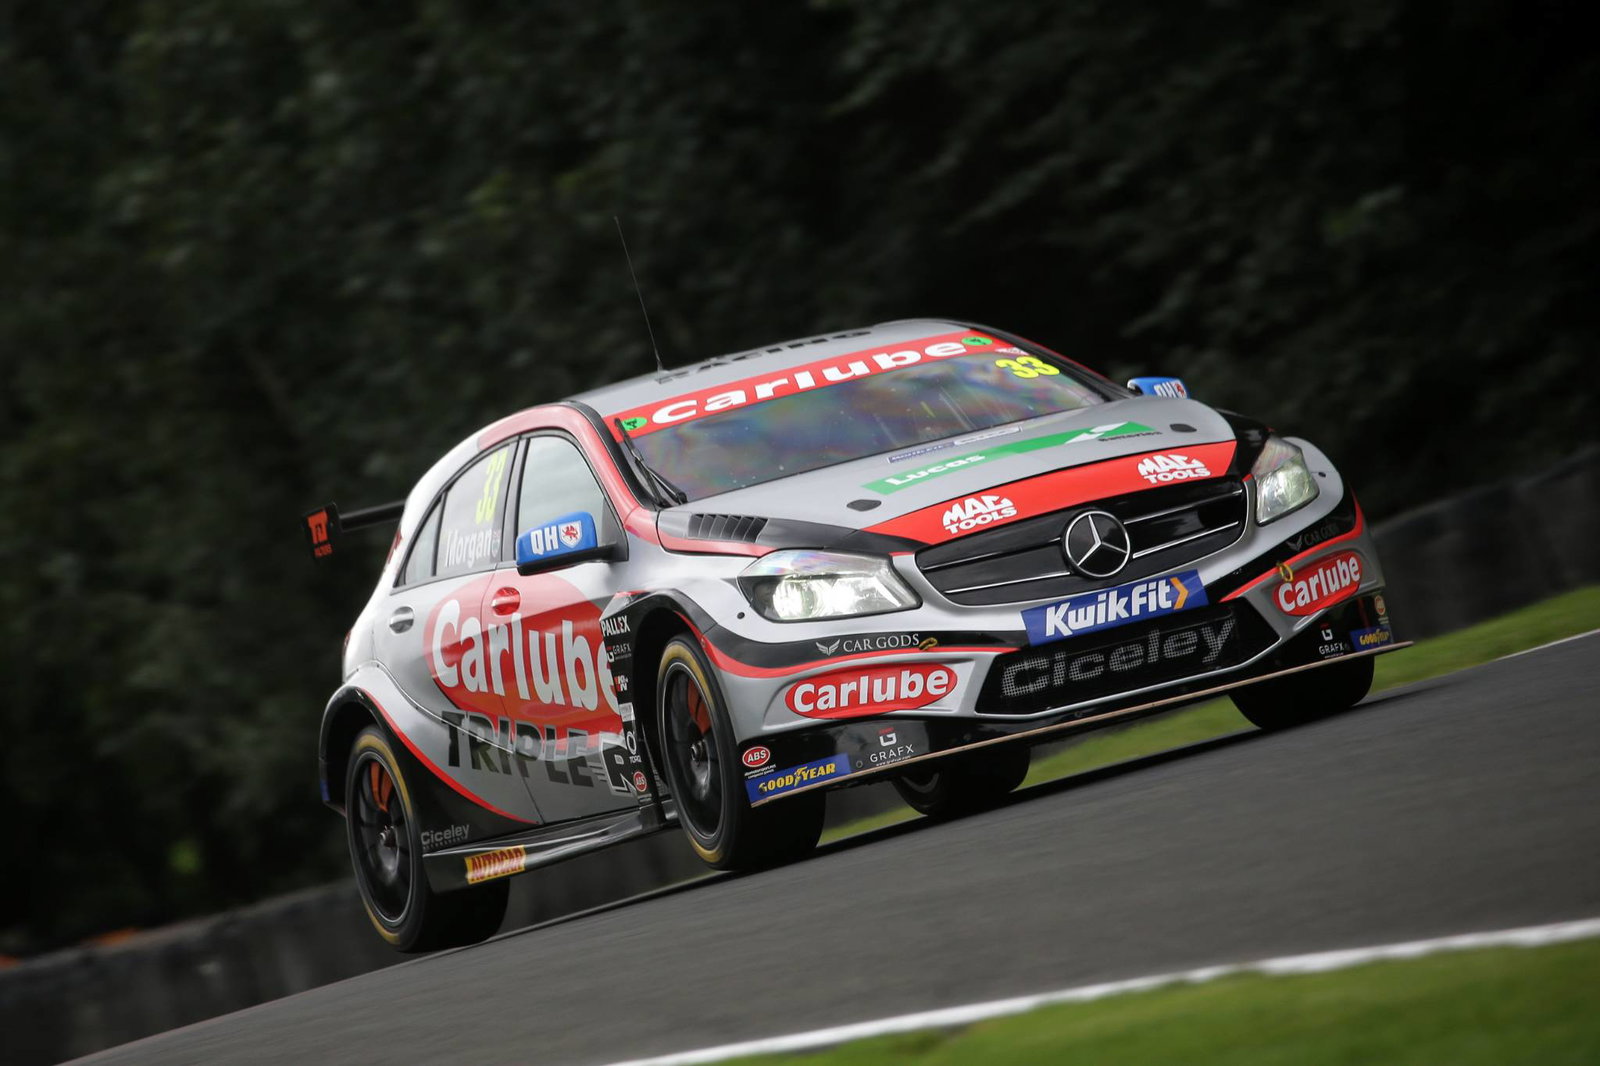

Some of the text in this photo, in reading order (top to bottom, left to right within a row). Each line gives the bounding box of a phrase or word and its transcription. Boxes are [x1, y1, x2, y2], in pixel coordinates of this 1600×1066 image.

[995, 356, 1060, 379] 33
[884, 453, 986, 487] Lucas
[1137, 453, 1206, 477] MAC
[1142, 466, 1212, 485] TOOLS
[474, 448, 508, 525] 33
[942, 494, 1014, 527] MAC
[945, 505, 1018, 535] TOOLS
[444, 528, 493, 569] Morgan
[530, 524, 560, 556] QH
[1277, 556, 1361, 612] Carlube
[843, 632, 920, 653] CAR GODS
[1000, 617, 1236, 698] Ciceley
[1318, 642, 1344, 655] GRAFX
[793, 668, 950, 714] Carlube
[440, 709, 595, 788] TRIPLE
[747, 749, 767, 764] ABS
[870, 744, 914, 763] GRAFX
[758, 763, 836, 793] GOODYEAR
[420, 824, 470, 846] Ciceley
